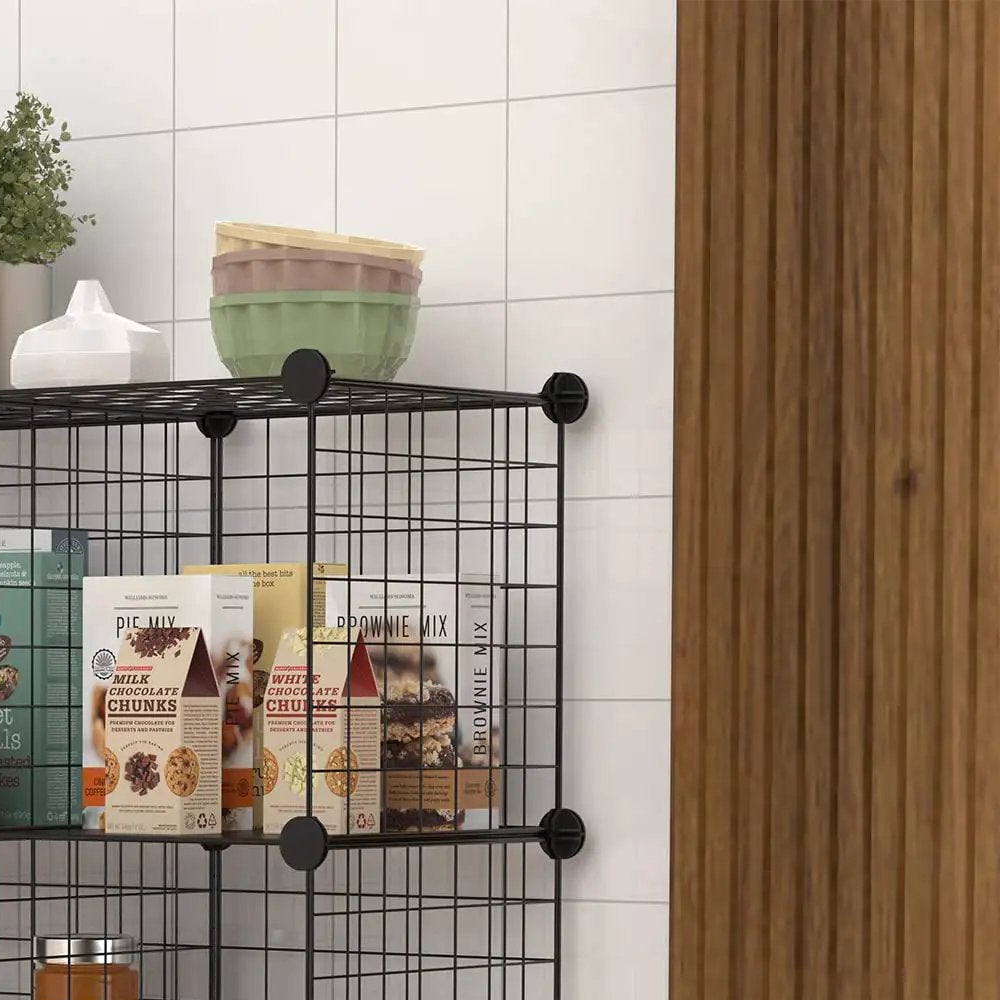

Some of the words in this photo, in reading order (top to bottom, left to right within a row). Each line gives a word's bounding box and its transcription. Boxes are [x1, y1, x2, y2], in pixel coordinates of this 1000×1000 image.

[422, 615, 448, 638] MIX
[474, 622, 488, 656] MIX
[225, 652, 240, 685] MIX
[112, 674, 151, 685] MILK
[272, 674, 321, 685] WHITE
[109, 687, 179, 696] CHOCOLATE
[267, 687, 340, 696] CHOCOATE
[108, 699, 177, 712] CHUNKS
[473, 667, 488, 755] BROWNIE
